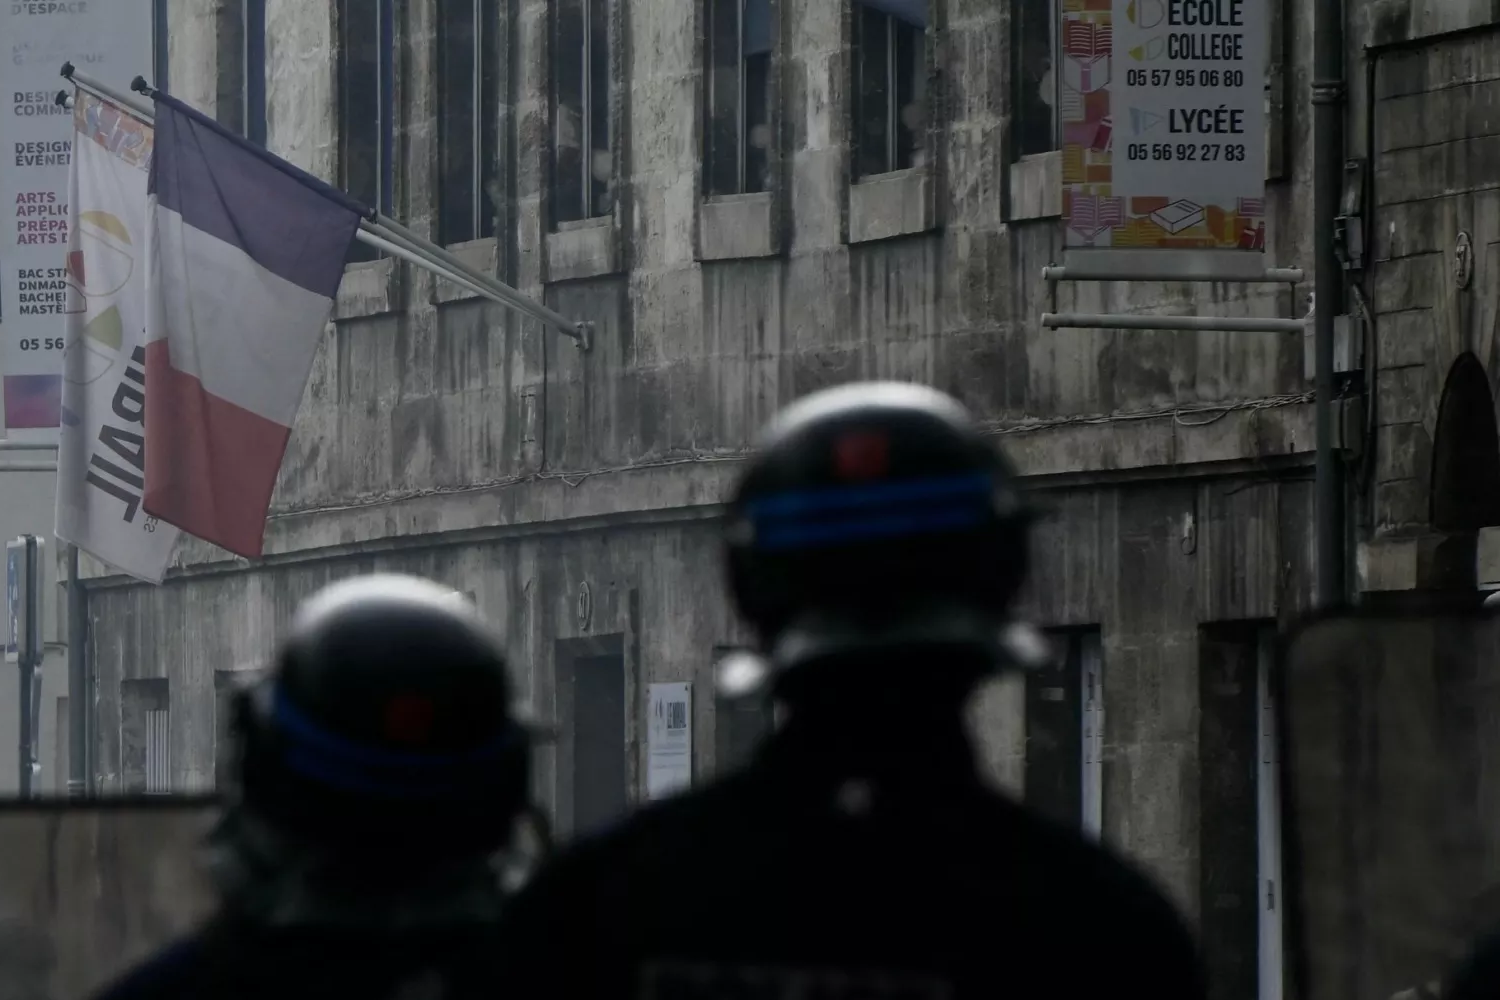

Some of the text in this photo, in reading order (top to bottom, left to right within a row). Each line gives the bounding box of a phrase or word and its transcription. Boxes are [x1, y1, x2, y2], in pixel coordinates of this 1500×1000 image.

[11, 2, 87, 15] D'ESPACE
[1168, 33, 1243, 60] COLLEGE
[1127, 69, 1243, 87] 05 57 95 06 80
[1169, 104, 1244, 133] LYCÉE
[15, 141, 71, 154] DESIGN
[1128, 143, 1245, 161] 05 56 92 27 83
[16, 192, 56, 204] ARTS
[17, 217, 68, 232] PRÉPA
[17, 233, 57, 245] ARTS
[18, 268, 44, 279] BAC
[19, 280, 66, 291] DNMAD
[19, 337, 65, 351] 05 56
